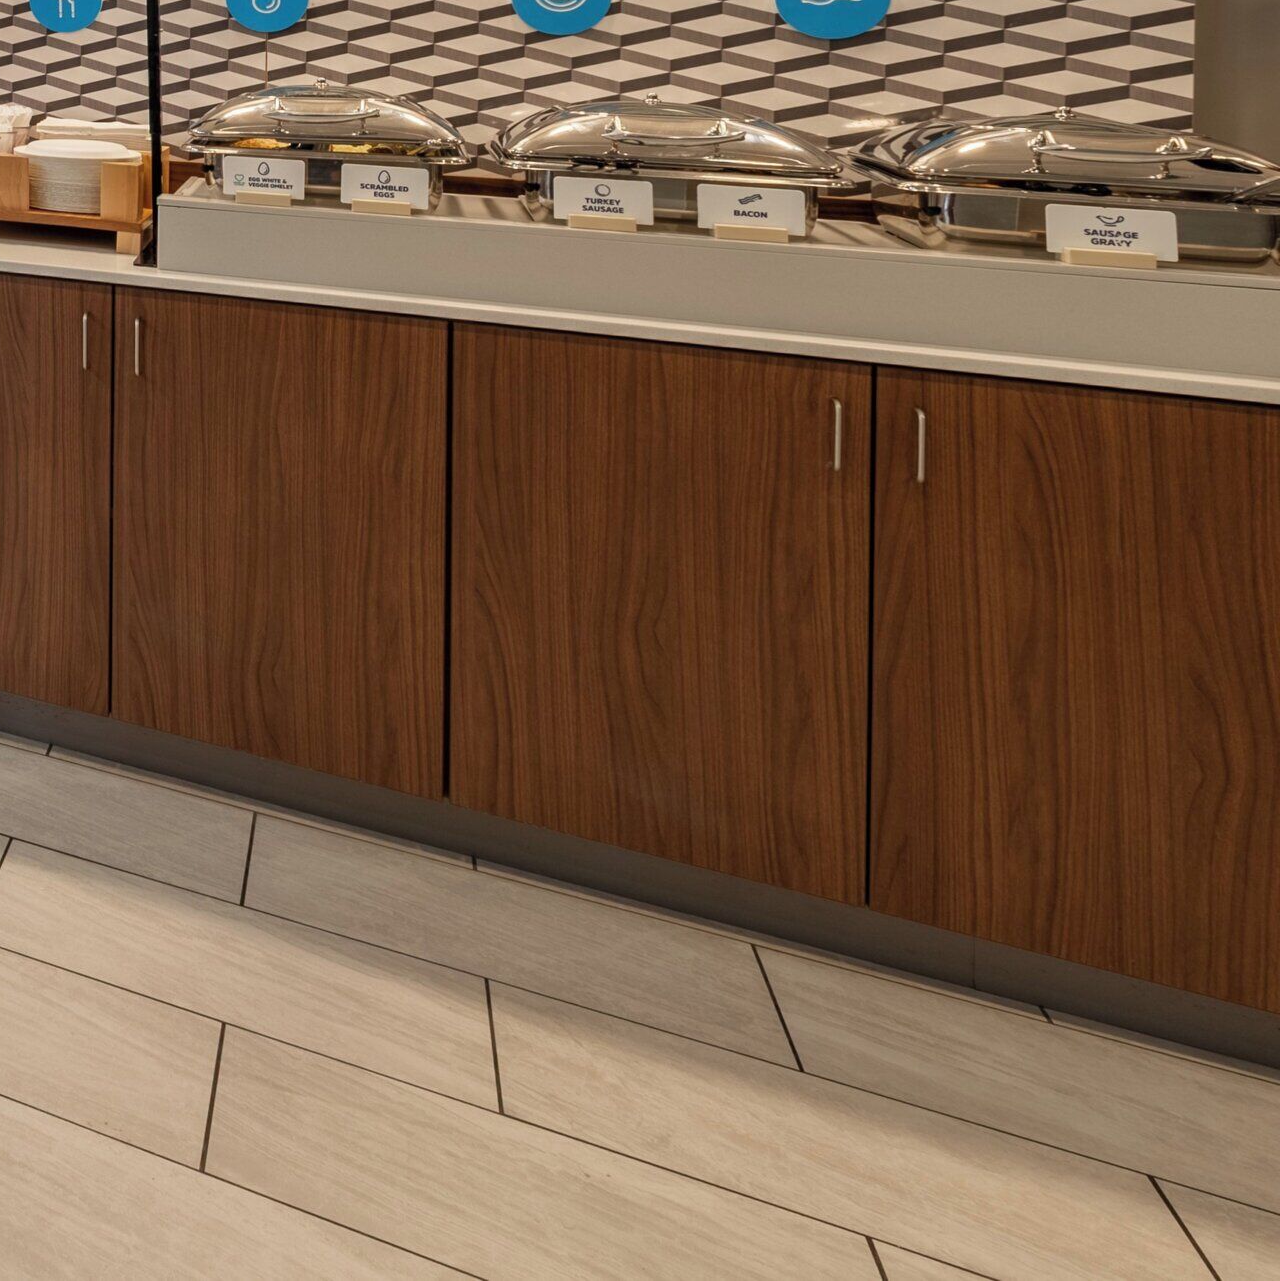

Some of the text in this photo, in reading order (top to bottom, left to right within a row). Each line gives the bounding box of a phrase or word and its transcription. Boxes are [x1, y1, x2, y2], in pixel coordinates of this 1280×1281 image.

[359, 182, 410, 193] SCRAMBLED
[373, 191, 395, 199] EGGS
[584, 197, 621, 206] TURKEY
[582, 204, 624, 214] SAUSAGE
[733, 209, 769, 219] BACON
[1083, 228, 1139, 239] SAUSAGE
[1090, 237, 1132, 247] GRAVY
